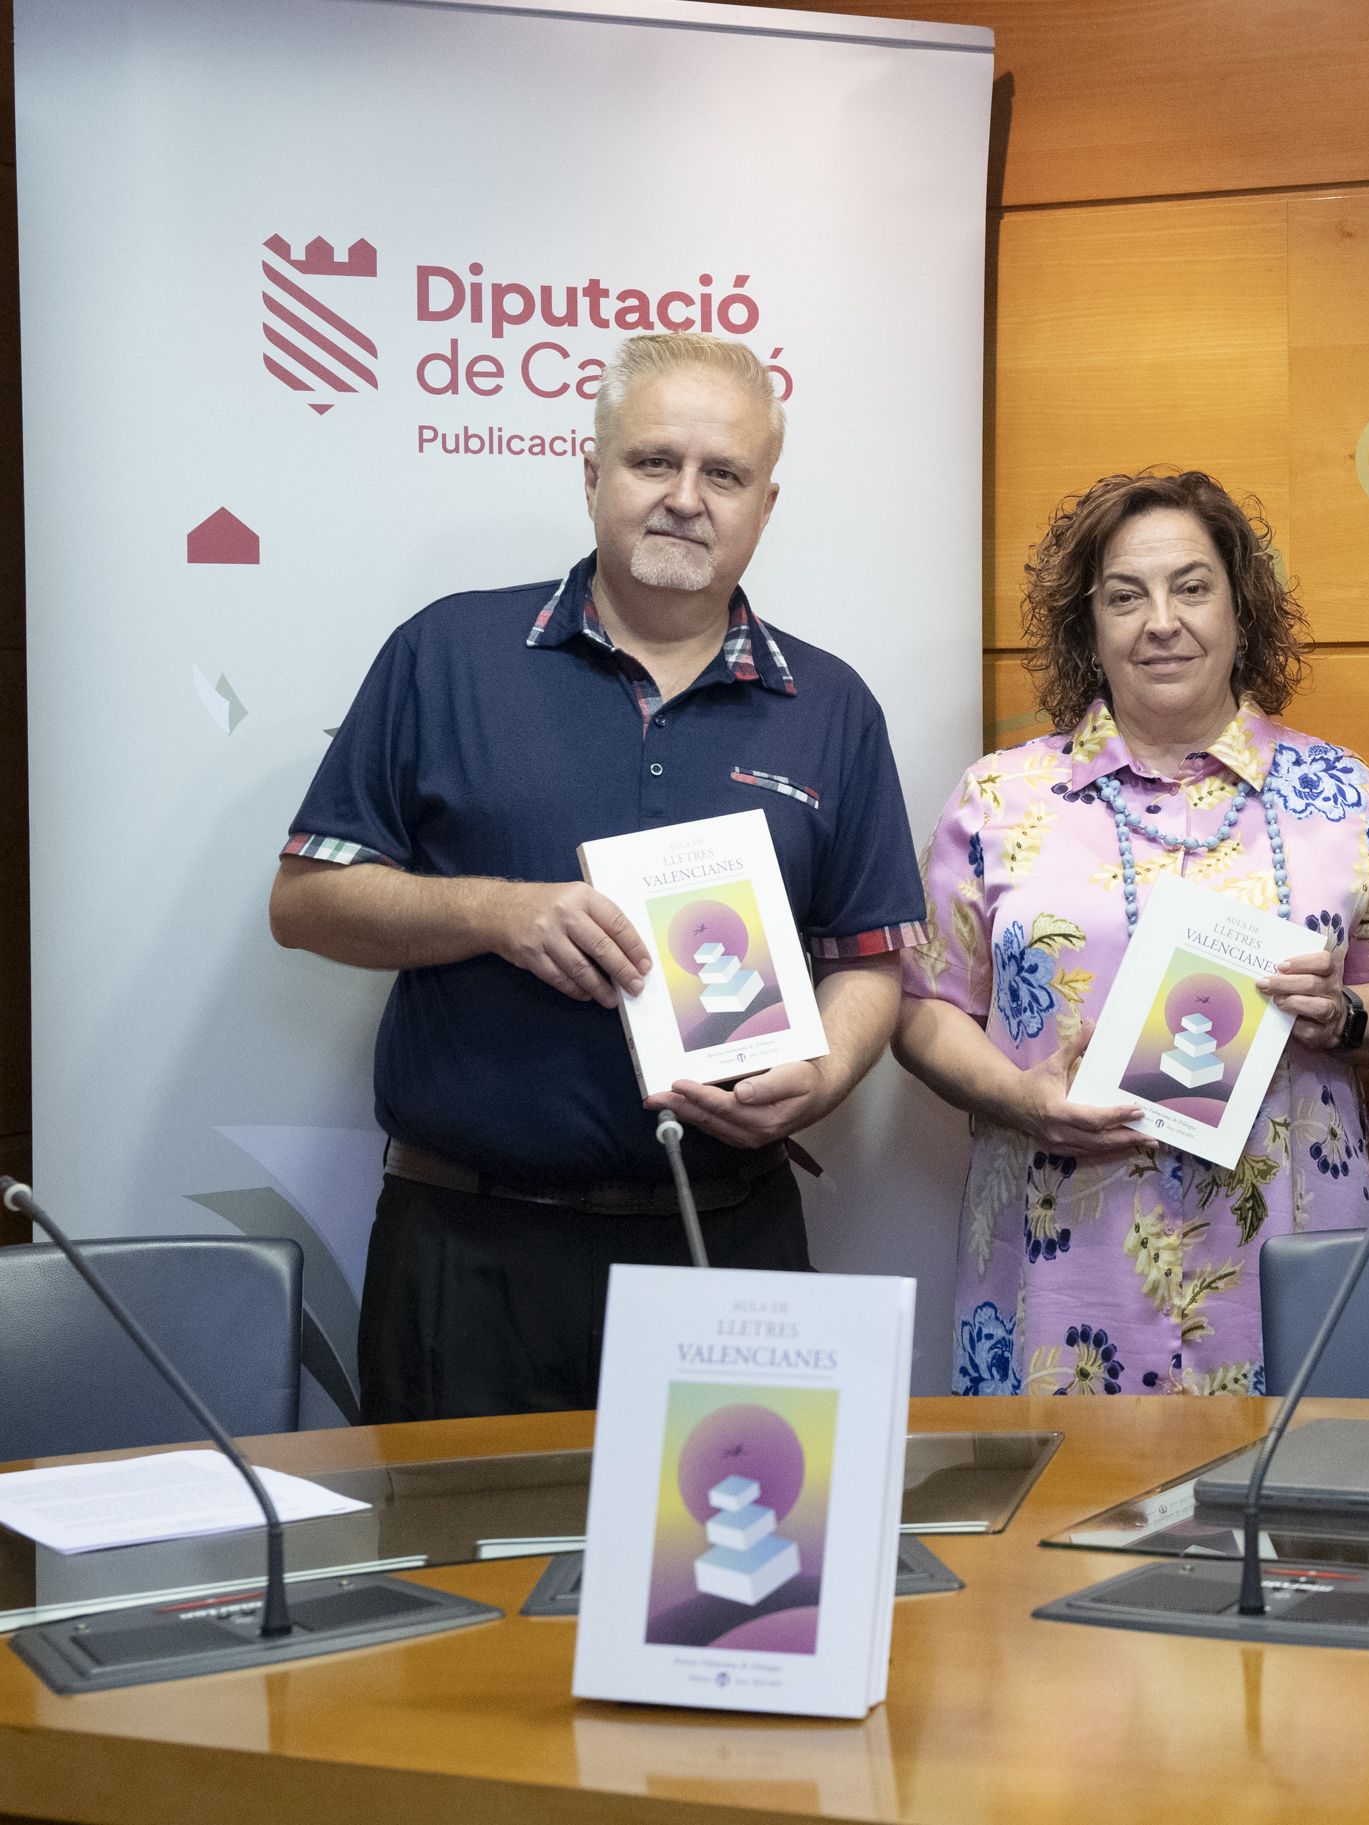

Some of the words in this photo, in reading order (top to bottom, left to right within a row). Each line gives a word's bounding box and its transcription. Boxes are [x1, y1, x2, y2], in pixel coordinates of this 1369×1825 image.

[416, 262, 760, 339] Diputació
[416, 338, 505, 397] de
[418, 425, 597, 457] Publicacio
[663, 848, 715, 867] LLETRES
[642, 857, 744, 888] VALENCIANES
[1213, 923, 1262, 950] LLETRES
[1225, 915, 1247, 930] AULA
[1187, 927, 1278, 975] VALENCIANES
[717, 1319, 800, 1339] LLETRES
[677, 1343, 838, 1370] VALENCIANES
